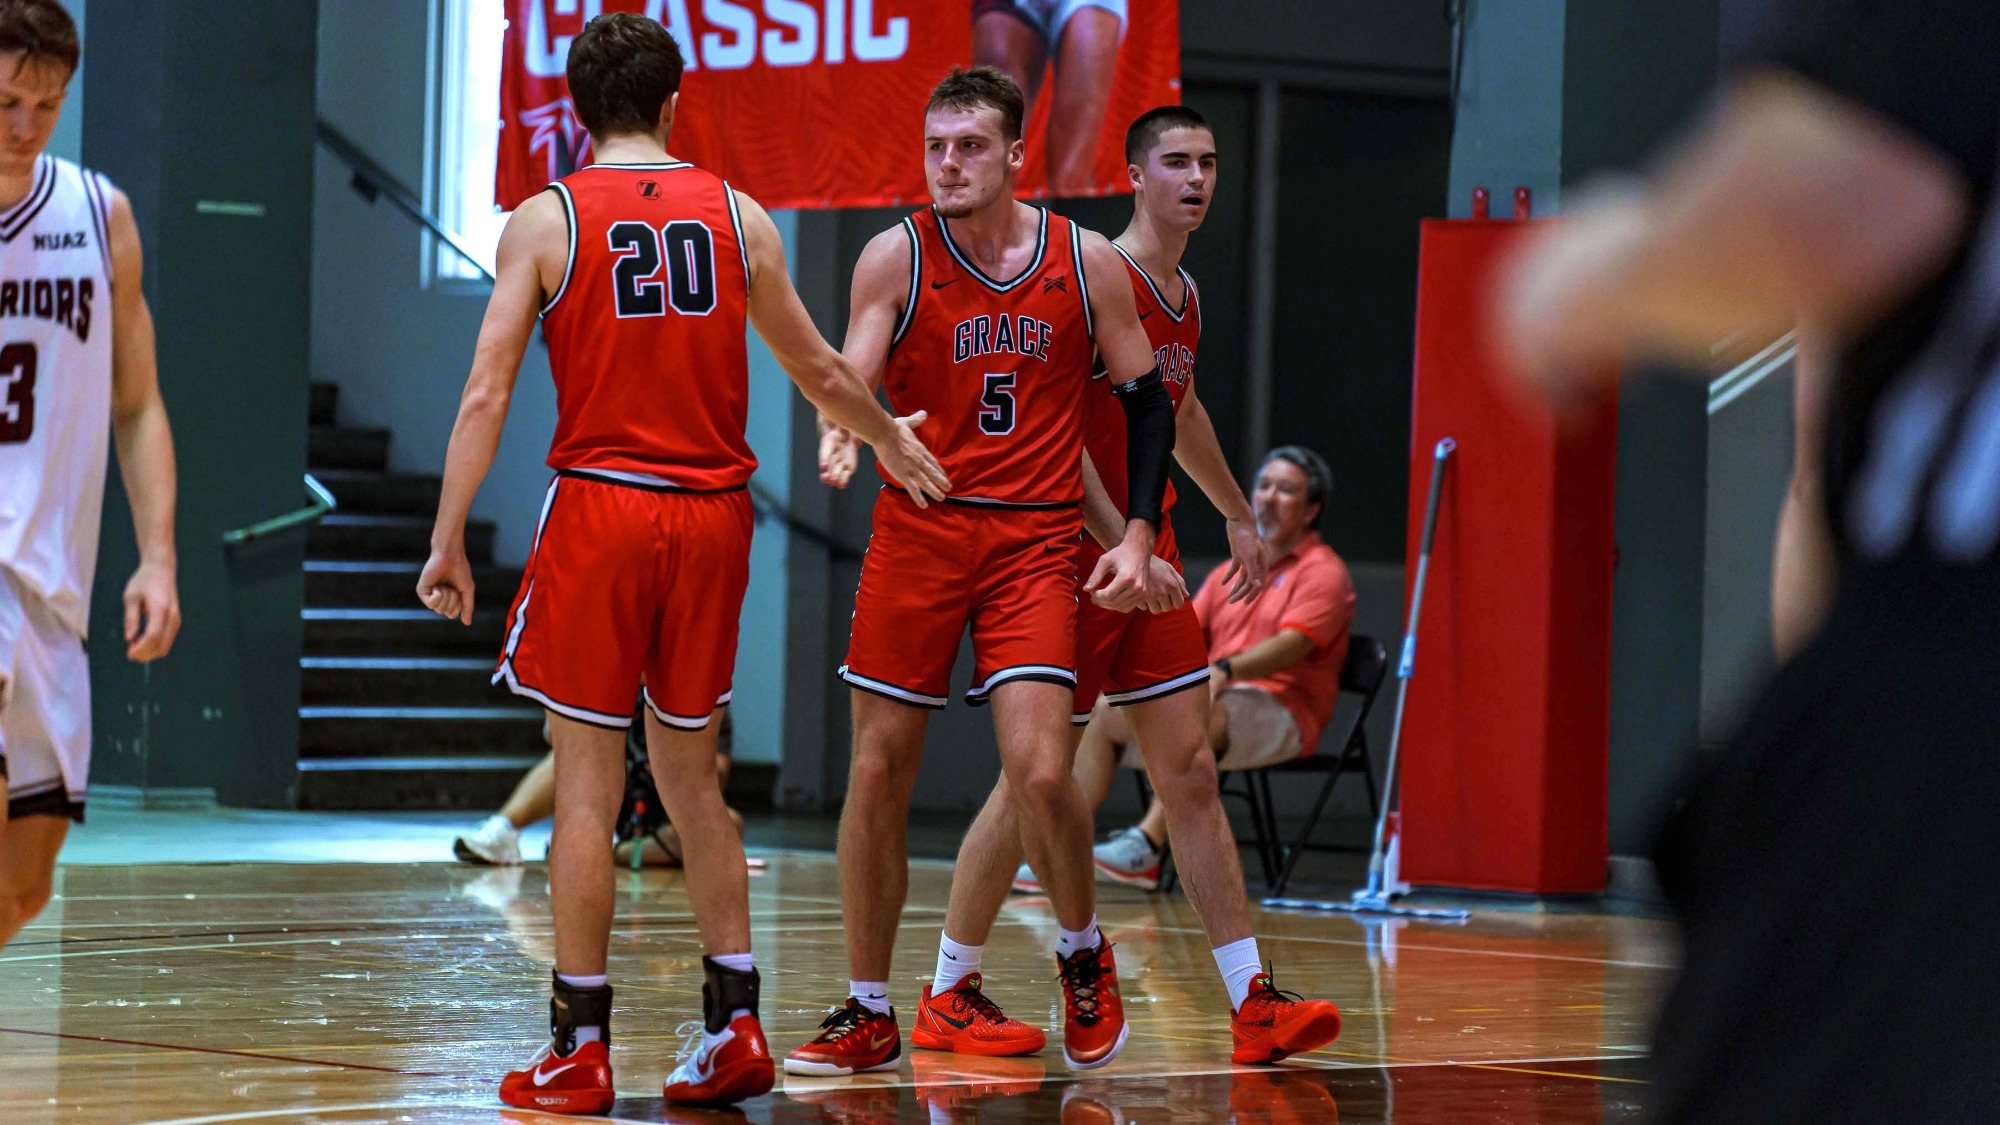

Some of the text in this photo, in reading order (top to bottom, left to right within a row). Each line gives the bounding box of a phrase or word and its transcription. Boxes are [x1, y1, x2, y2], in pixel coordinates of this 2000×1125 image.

[525, 0, 909, 77] CASSIC
[33, 231, 88, 251] NUAZ
[606, 219, 717, 319] 20
[953, 312, 1053, 364] GRACE
[0, 341, 38, 444] 3
[978, 371, 1018, 436] 5
